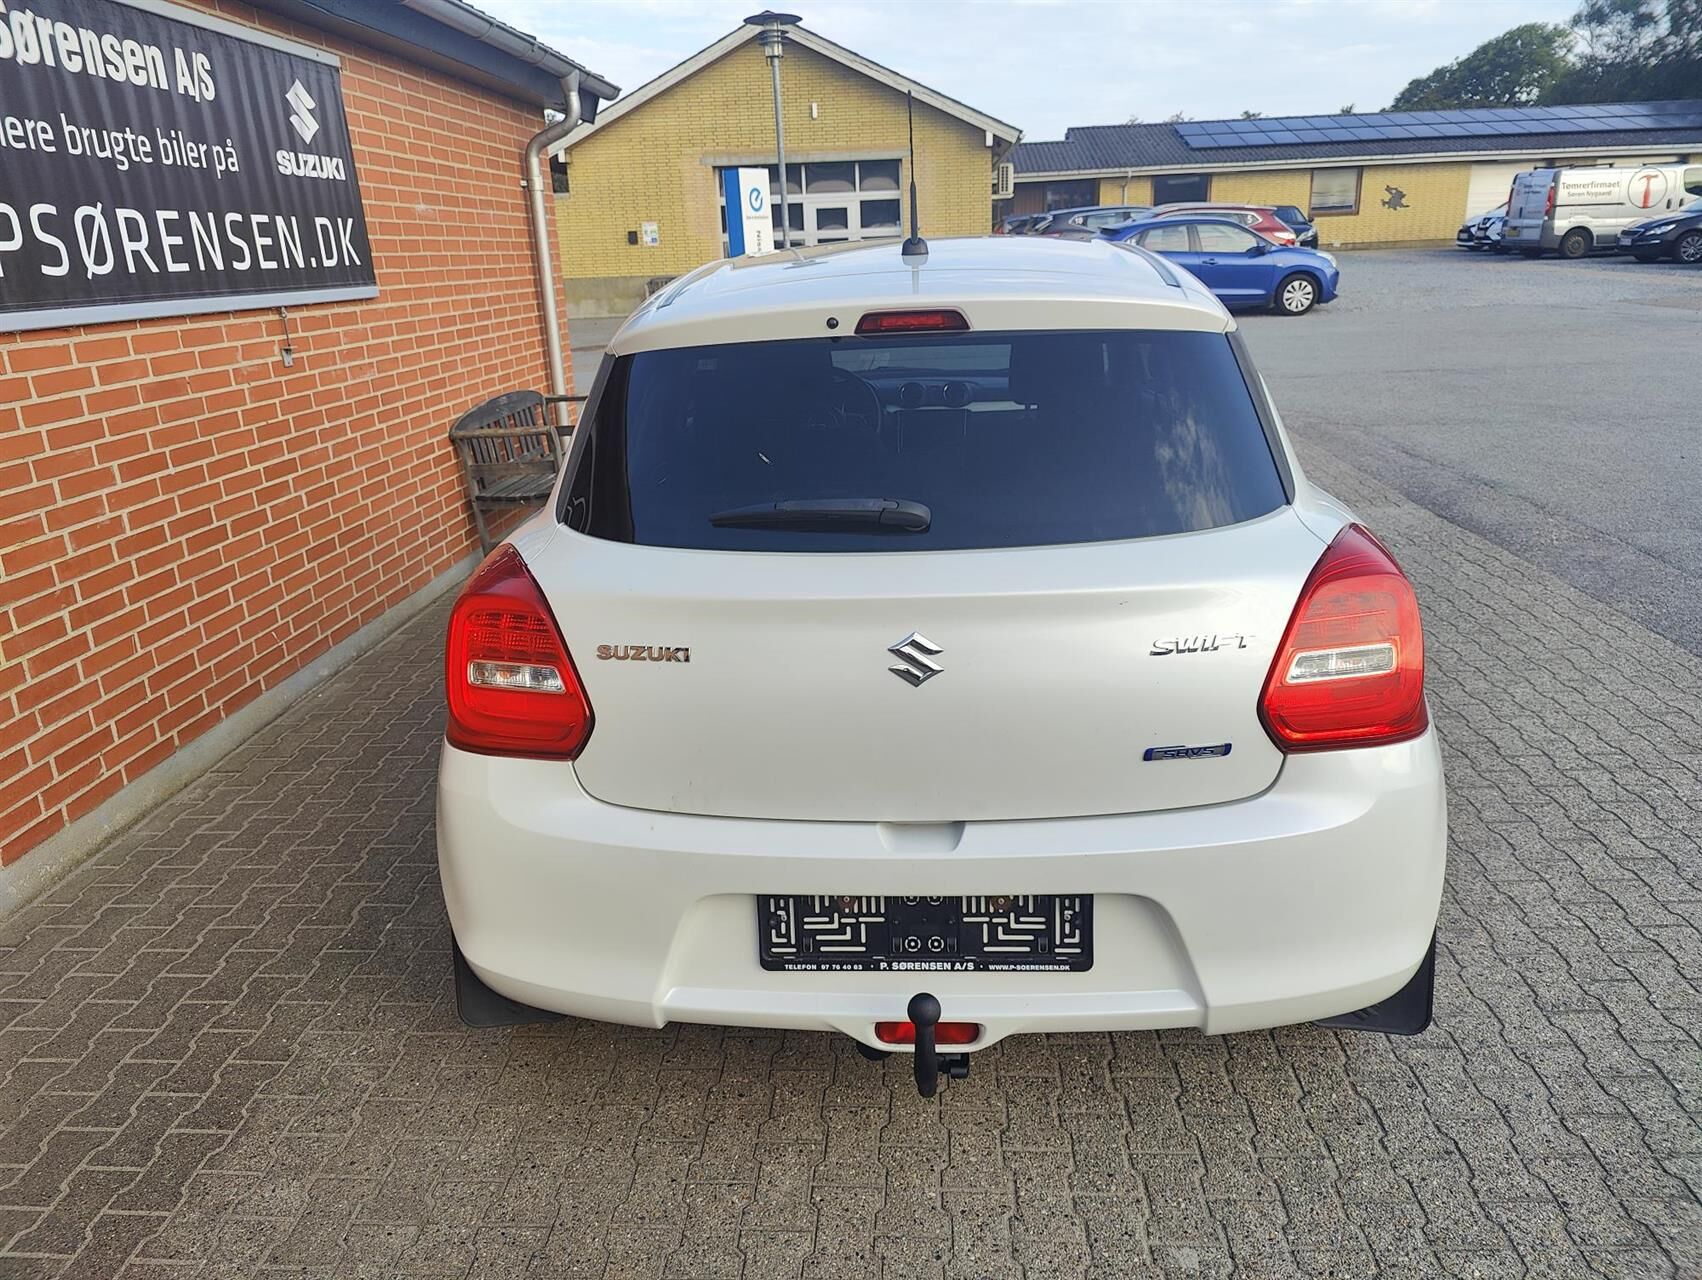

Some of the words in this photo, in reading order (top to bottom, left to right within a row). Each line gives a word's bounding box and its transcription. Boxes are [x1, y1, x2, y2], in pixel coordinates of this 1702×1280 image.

[175, 47, 216, 102] A/S
[59, 112, 152, 171] brugte
[157, 127, 207, 169] biler
[212, 138, 239, 179] på
[276, 149, 346, 181] SUZUKI
[1562, 181, 1620, 190] Tømrerfirmaet
[596, 644, 690, 662] SUZUKI
[1149, 632, 1257, 656] SWIFT
[880, 962, 890, 970] P.
[891, 961, 952, 971] SØRENSEN
[953, 962, 975, 971] A/S
